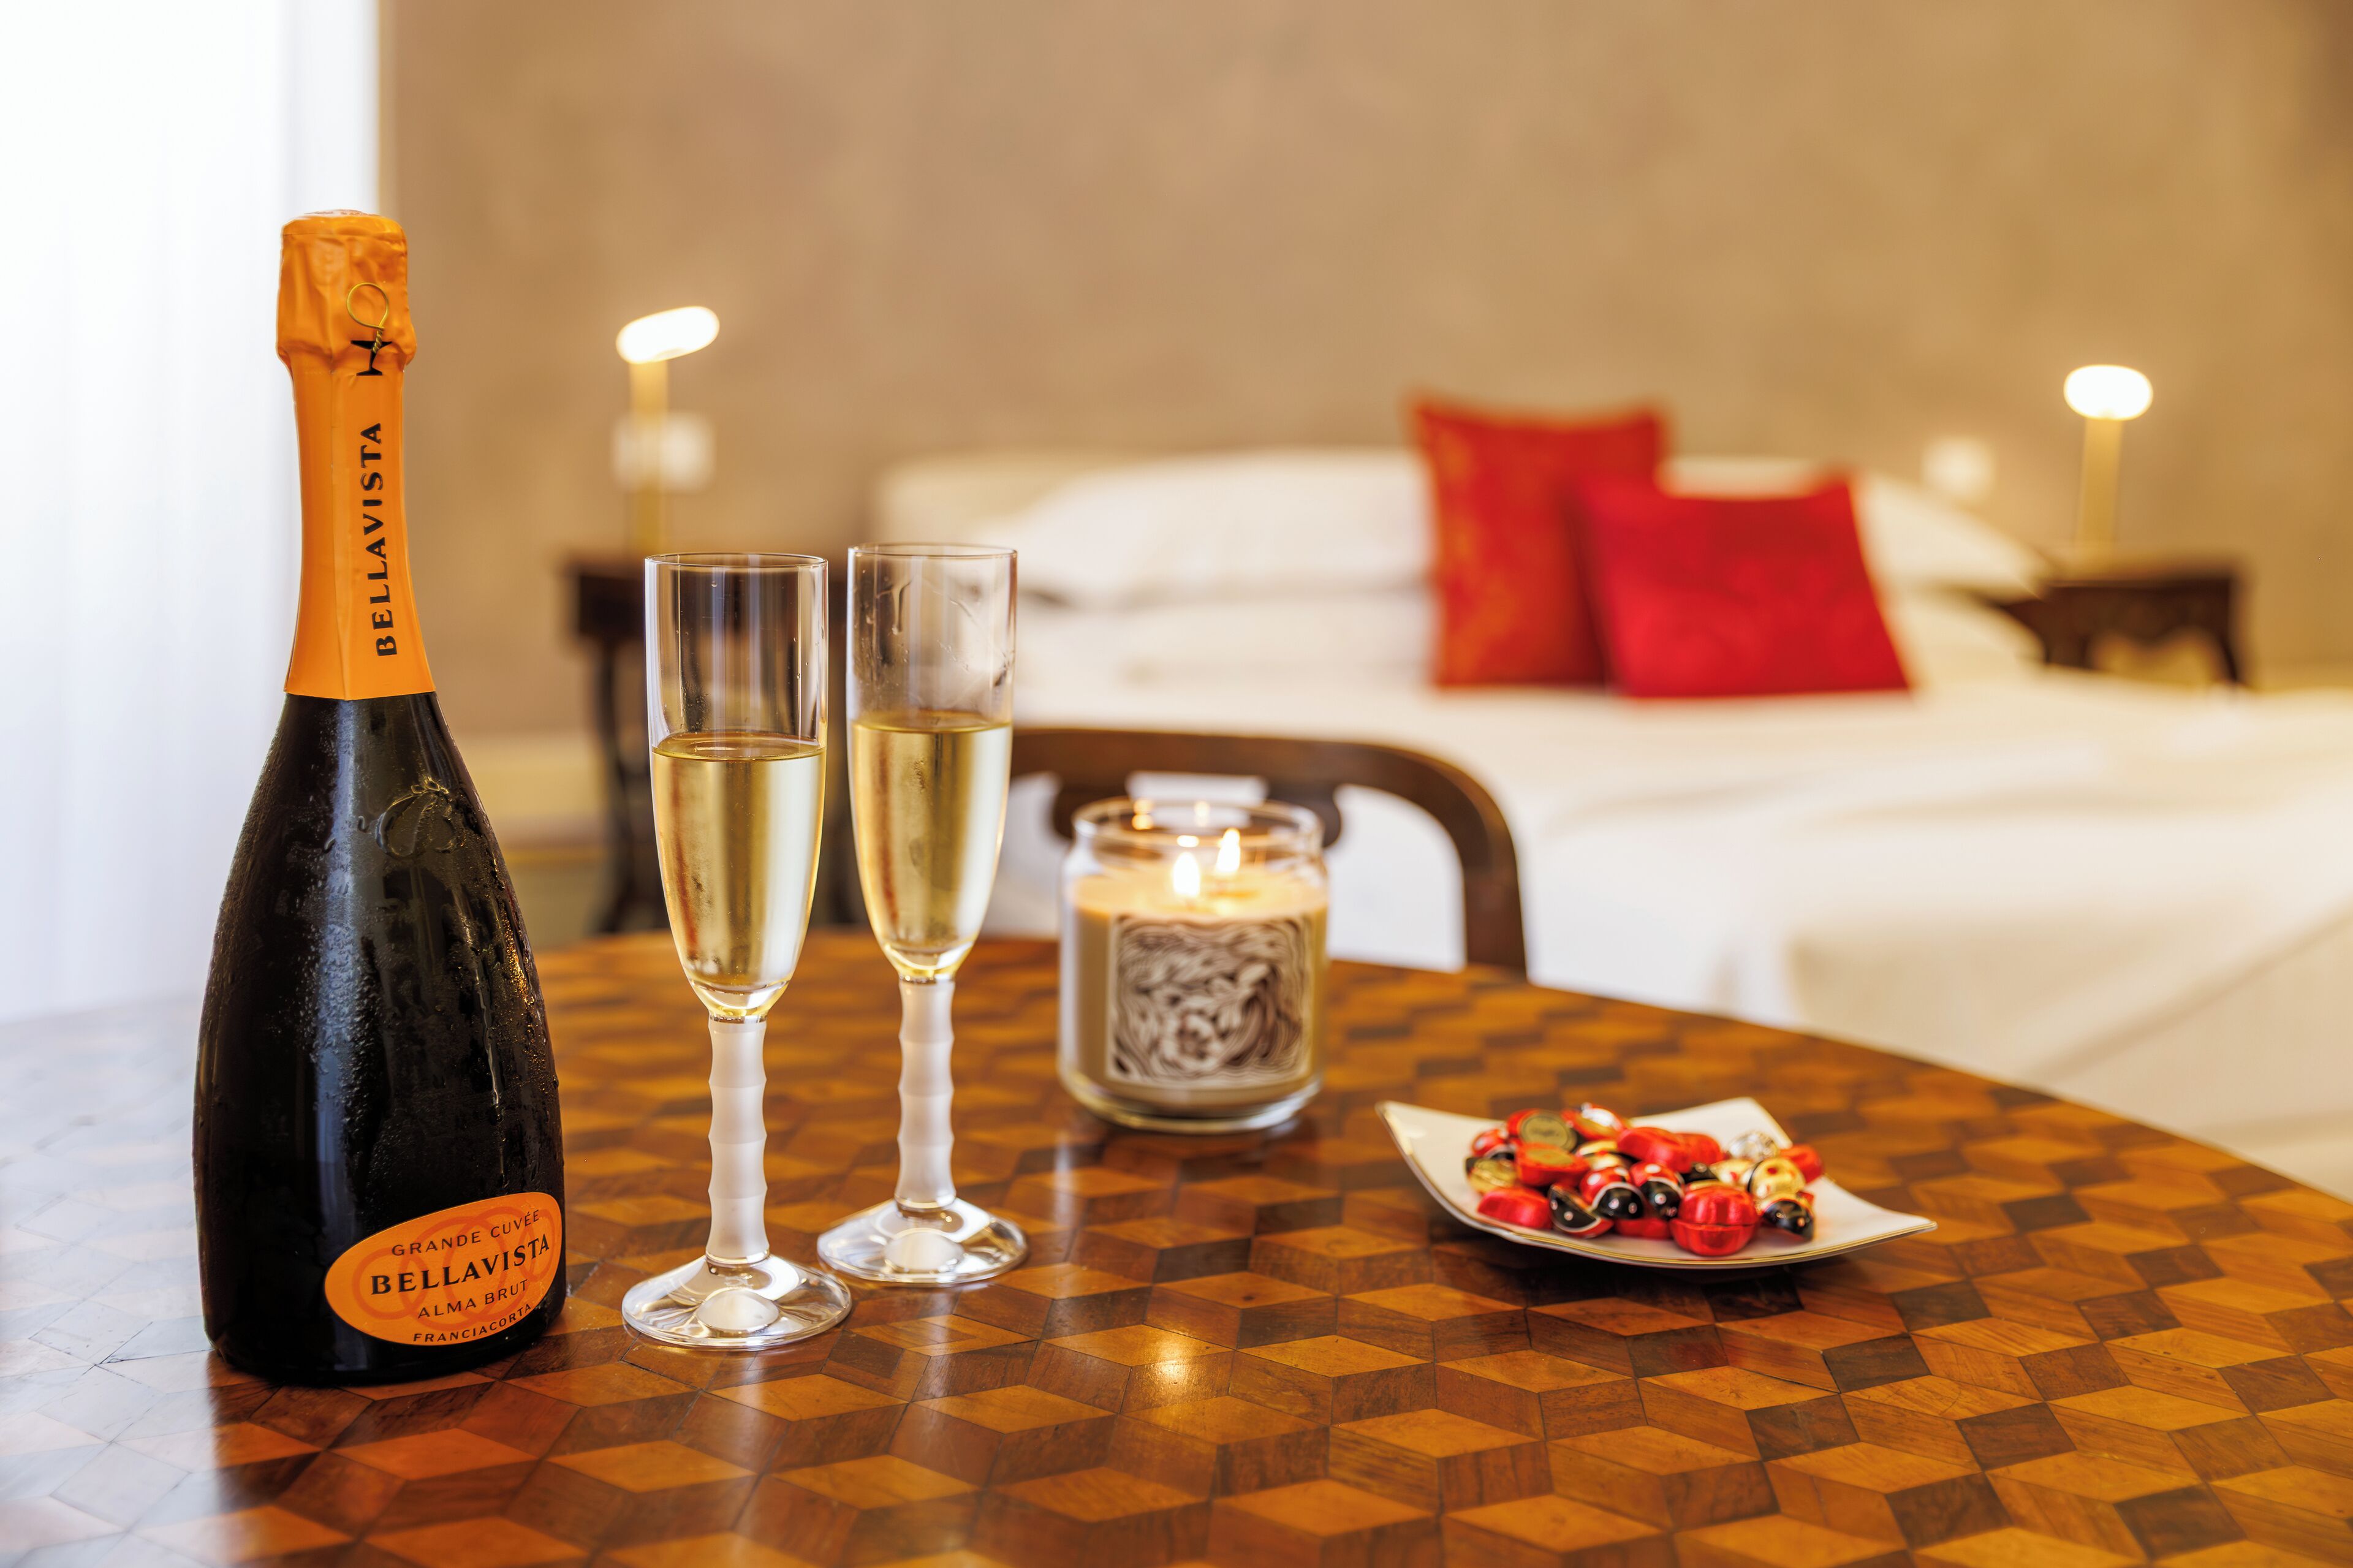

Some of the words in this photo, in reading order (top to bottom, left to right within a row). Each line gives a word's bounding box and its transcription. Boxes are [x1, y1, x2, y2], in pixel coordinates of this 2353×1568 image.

[360, 422, 398, 657] BELLAVISTA
[392, 1232, 481, 1256] GRANDE
[491, 1210, 540, 1238] CUVÉE
[371, 1234, 550, 1295] BELLAVISTA
[418, 1298, 477, 1319] ALMA
[485, 1279, 528, 1305] BRUT
[413, 1303, 532, 1343] FRANCIACORTA
